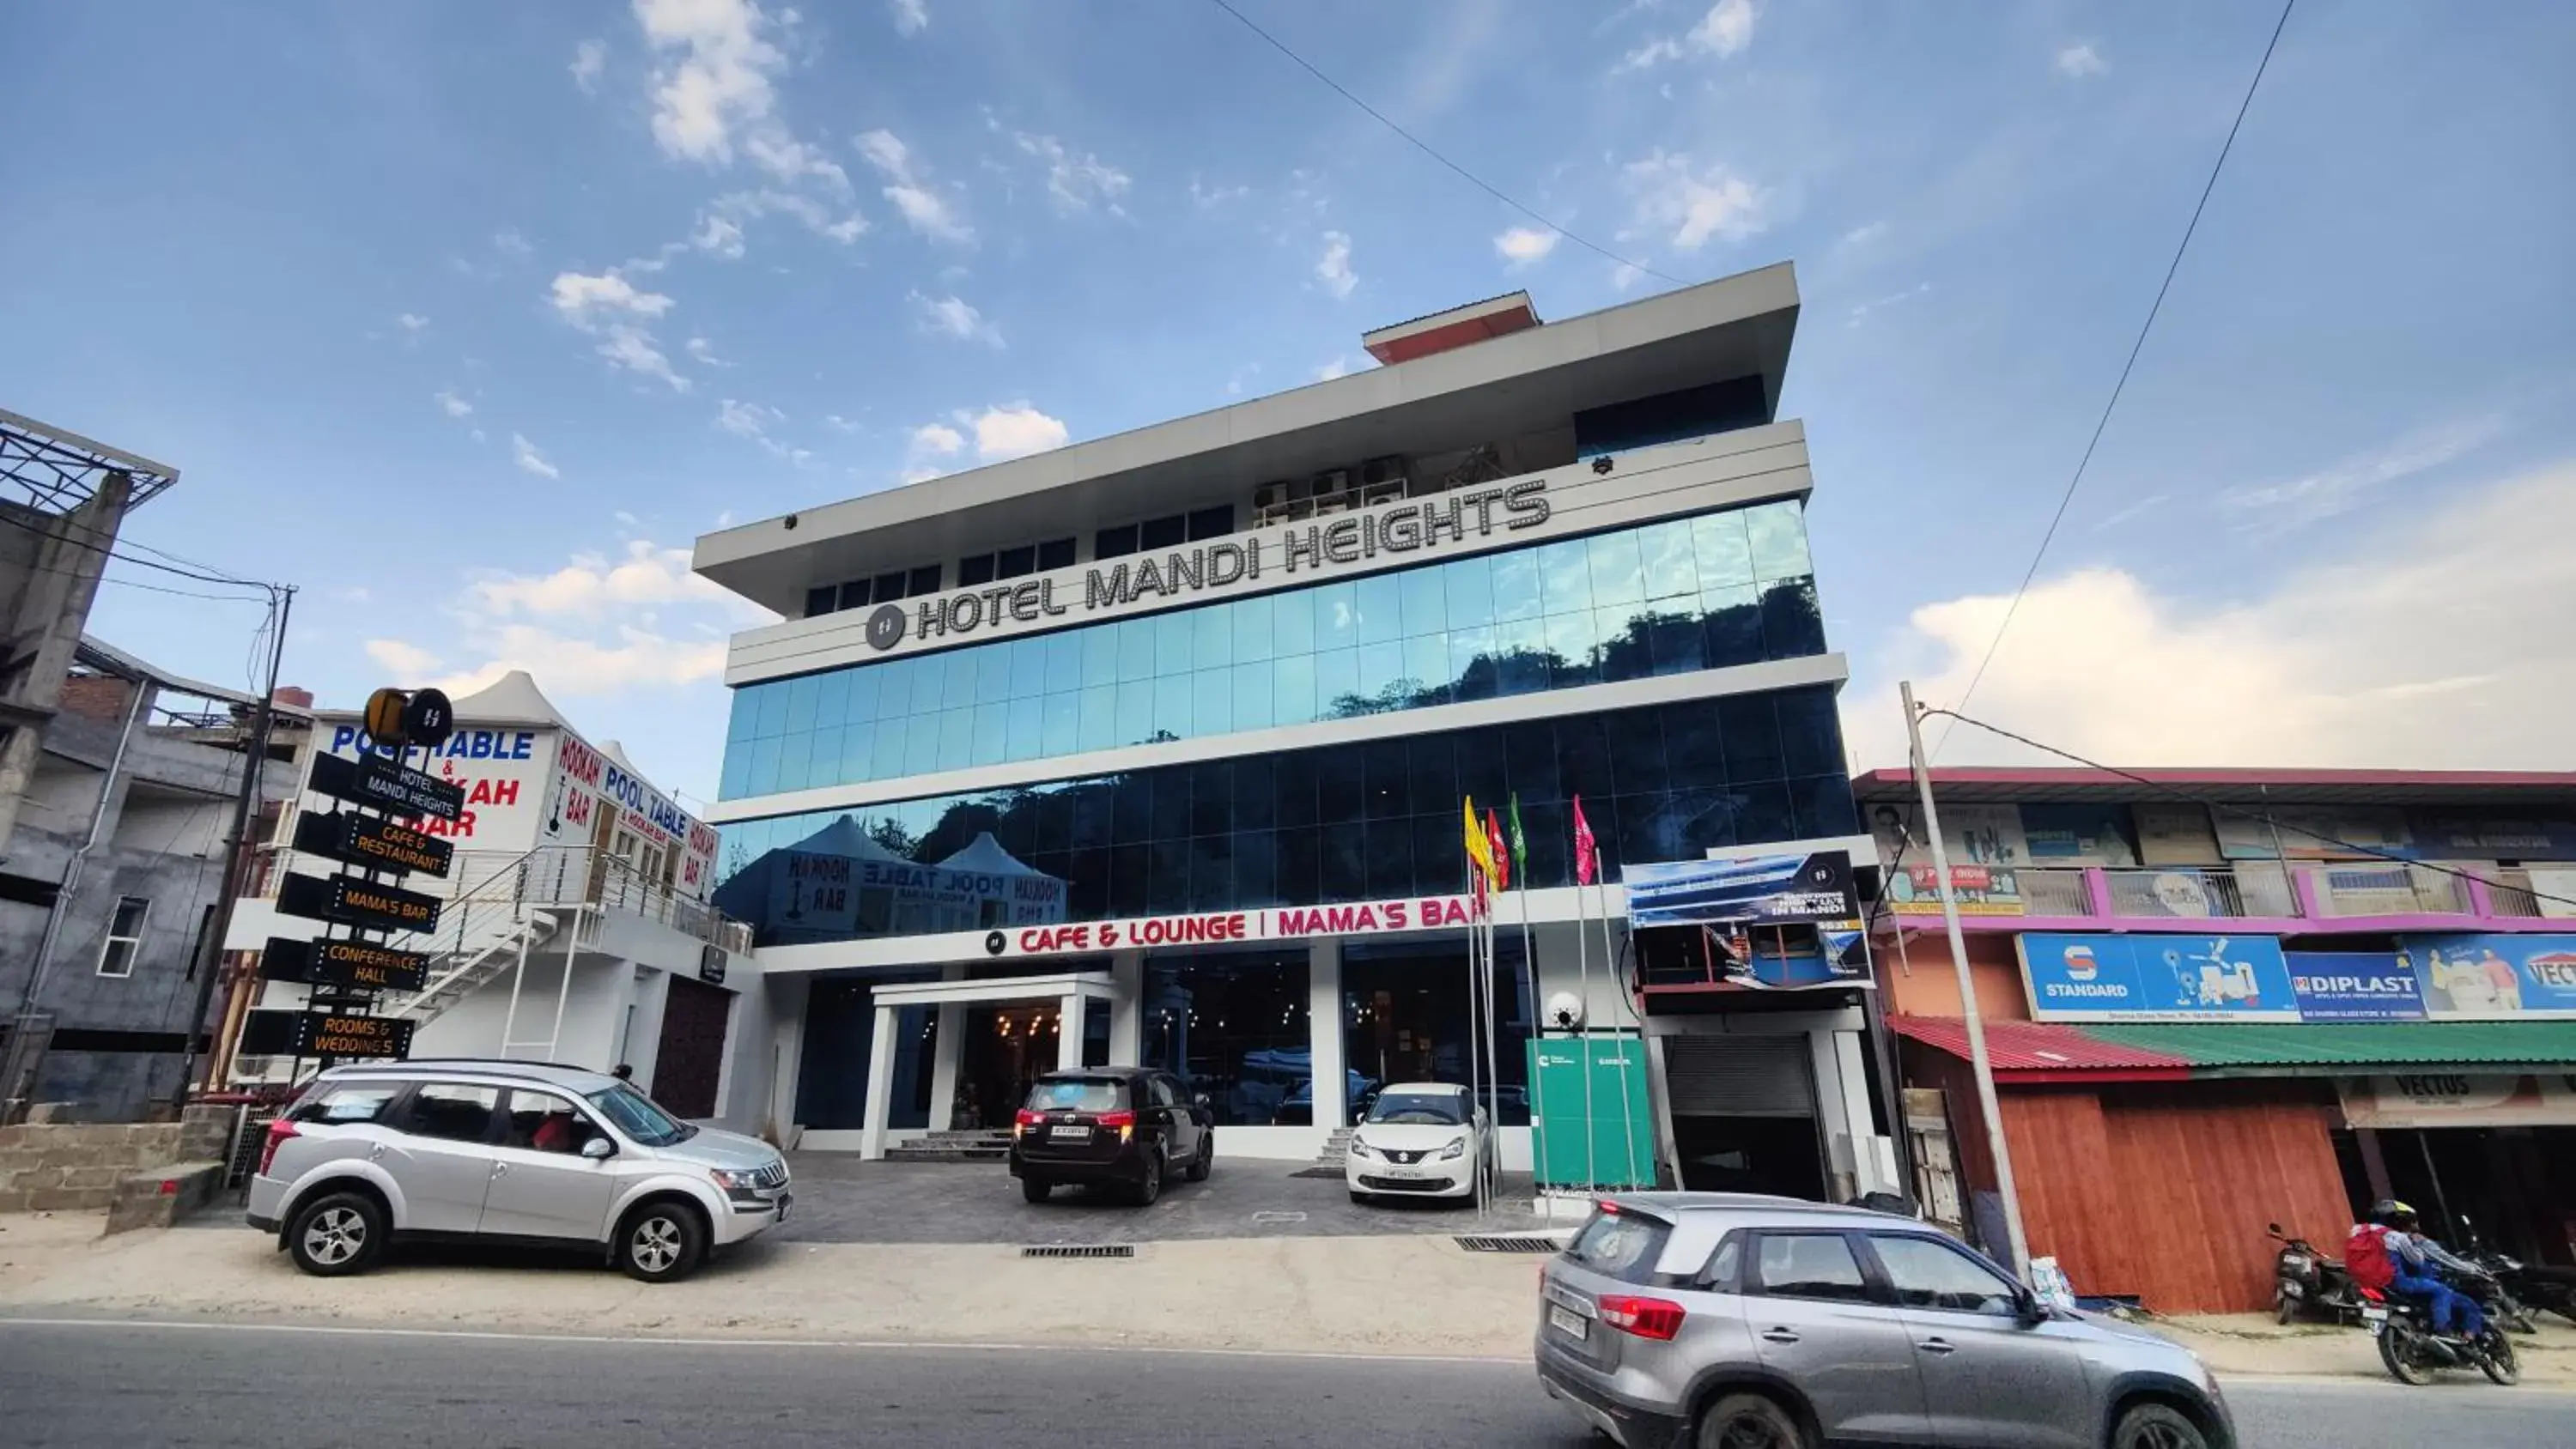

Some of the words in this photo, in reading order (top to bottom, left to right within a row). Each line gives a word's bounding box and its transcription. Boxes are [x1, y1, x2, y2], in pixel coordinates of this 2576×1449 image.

[917, 578, 1066, 640] HOTEL
[1085, 537, 1260, 610] MANDI
[1285, 478, 1551, 573] HEIGHTS
[559, 733, 602, 788] HOOKAH
[399, 769, 433, 792] HOTEL
[368, 776, 408, 802] MANDI
[409, 792, 455, 817] HEIGHTS
[566, 786, 591, 829] BAR
[605, 766, 645, 814] POOL
[648, 794, 687, 839] TABLE
[382, 827, 416, 847] CAFE
[356, 835, 442, 870] RESTAURANT
[401, 906, 429, 921] BAR
[1020, 925, 1089, 953] CAFE
[1099, 923, 1120, 947] &
[1129, 914, 1246, 945] LOUNGE
[1279, 902, 1407, 937] MAMA'S
[329, 945, 419, 971] CONFERENCE
[355, 967, 387, 984] HALL
[2310, 976, 2415, 992] DIPLAST
[2045, 983, 2129, 997] STANDARD
[324, 1018, 377, 1035] ROOMS
[315, 1036, 393, 1054] WEDDINGS
[2396, 1074, 2470, 1096] VECTUS
